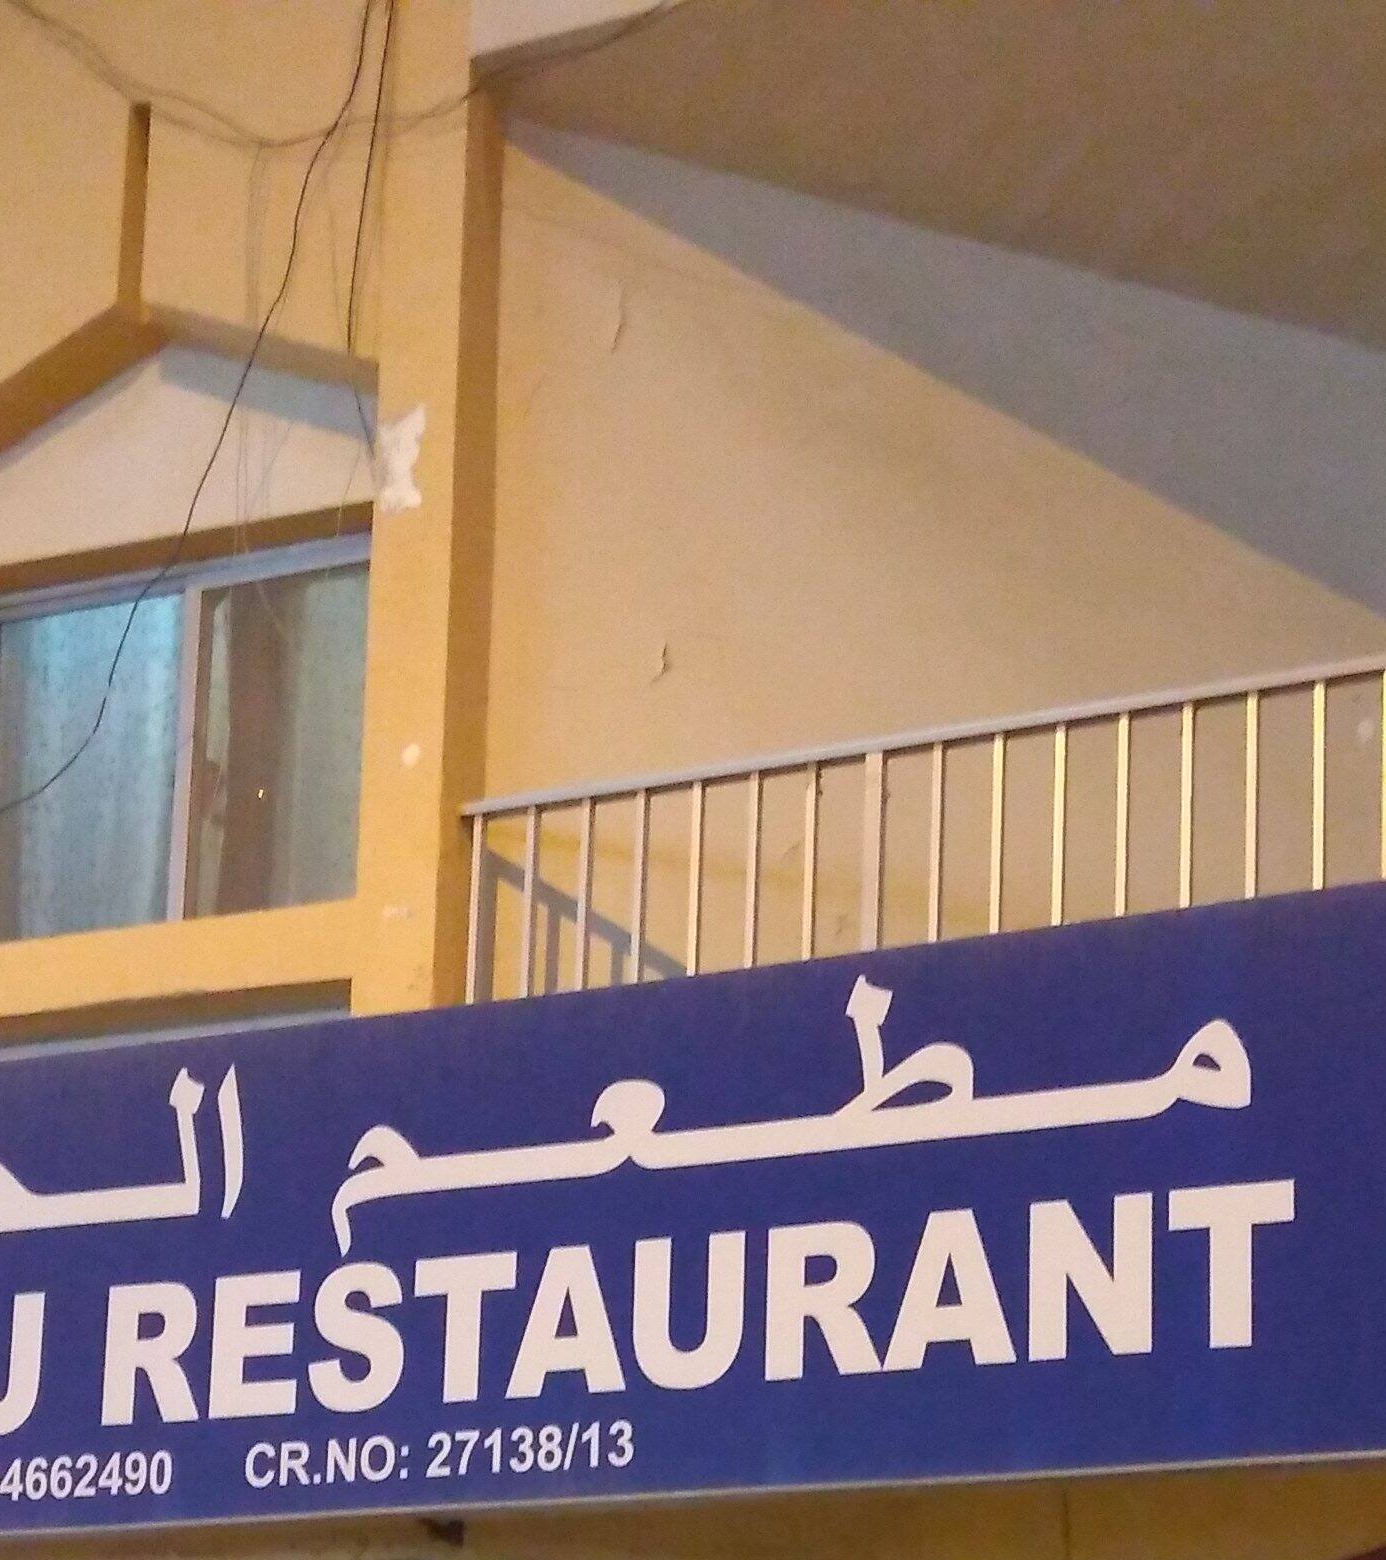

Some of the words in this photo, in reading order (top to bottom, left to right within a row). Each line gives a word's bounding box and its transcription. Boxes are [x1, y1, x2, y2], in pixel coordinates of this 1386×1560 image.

[330, 973, 1254, 1258] مطعم
[100, 1178, 1296, 1427] RESTAURANT
[243, 1434, 412, 1490] CR.NO:
[425, 1419, 636, 1479] 27138/13
